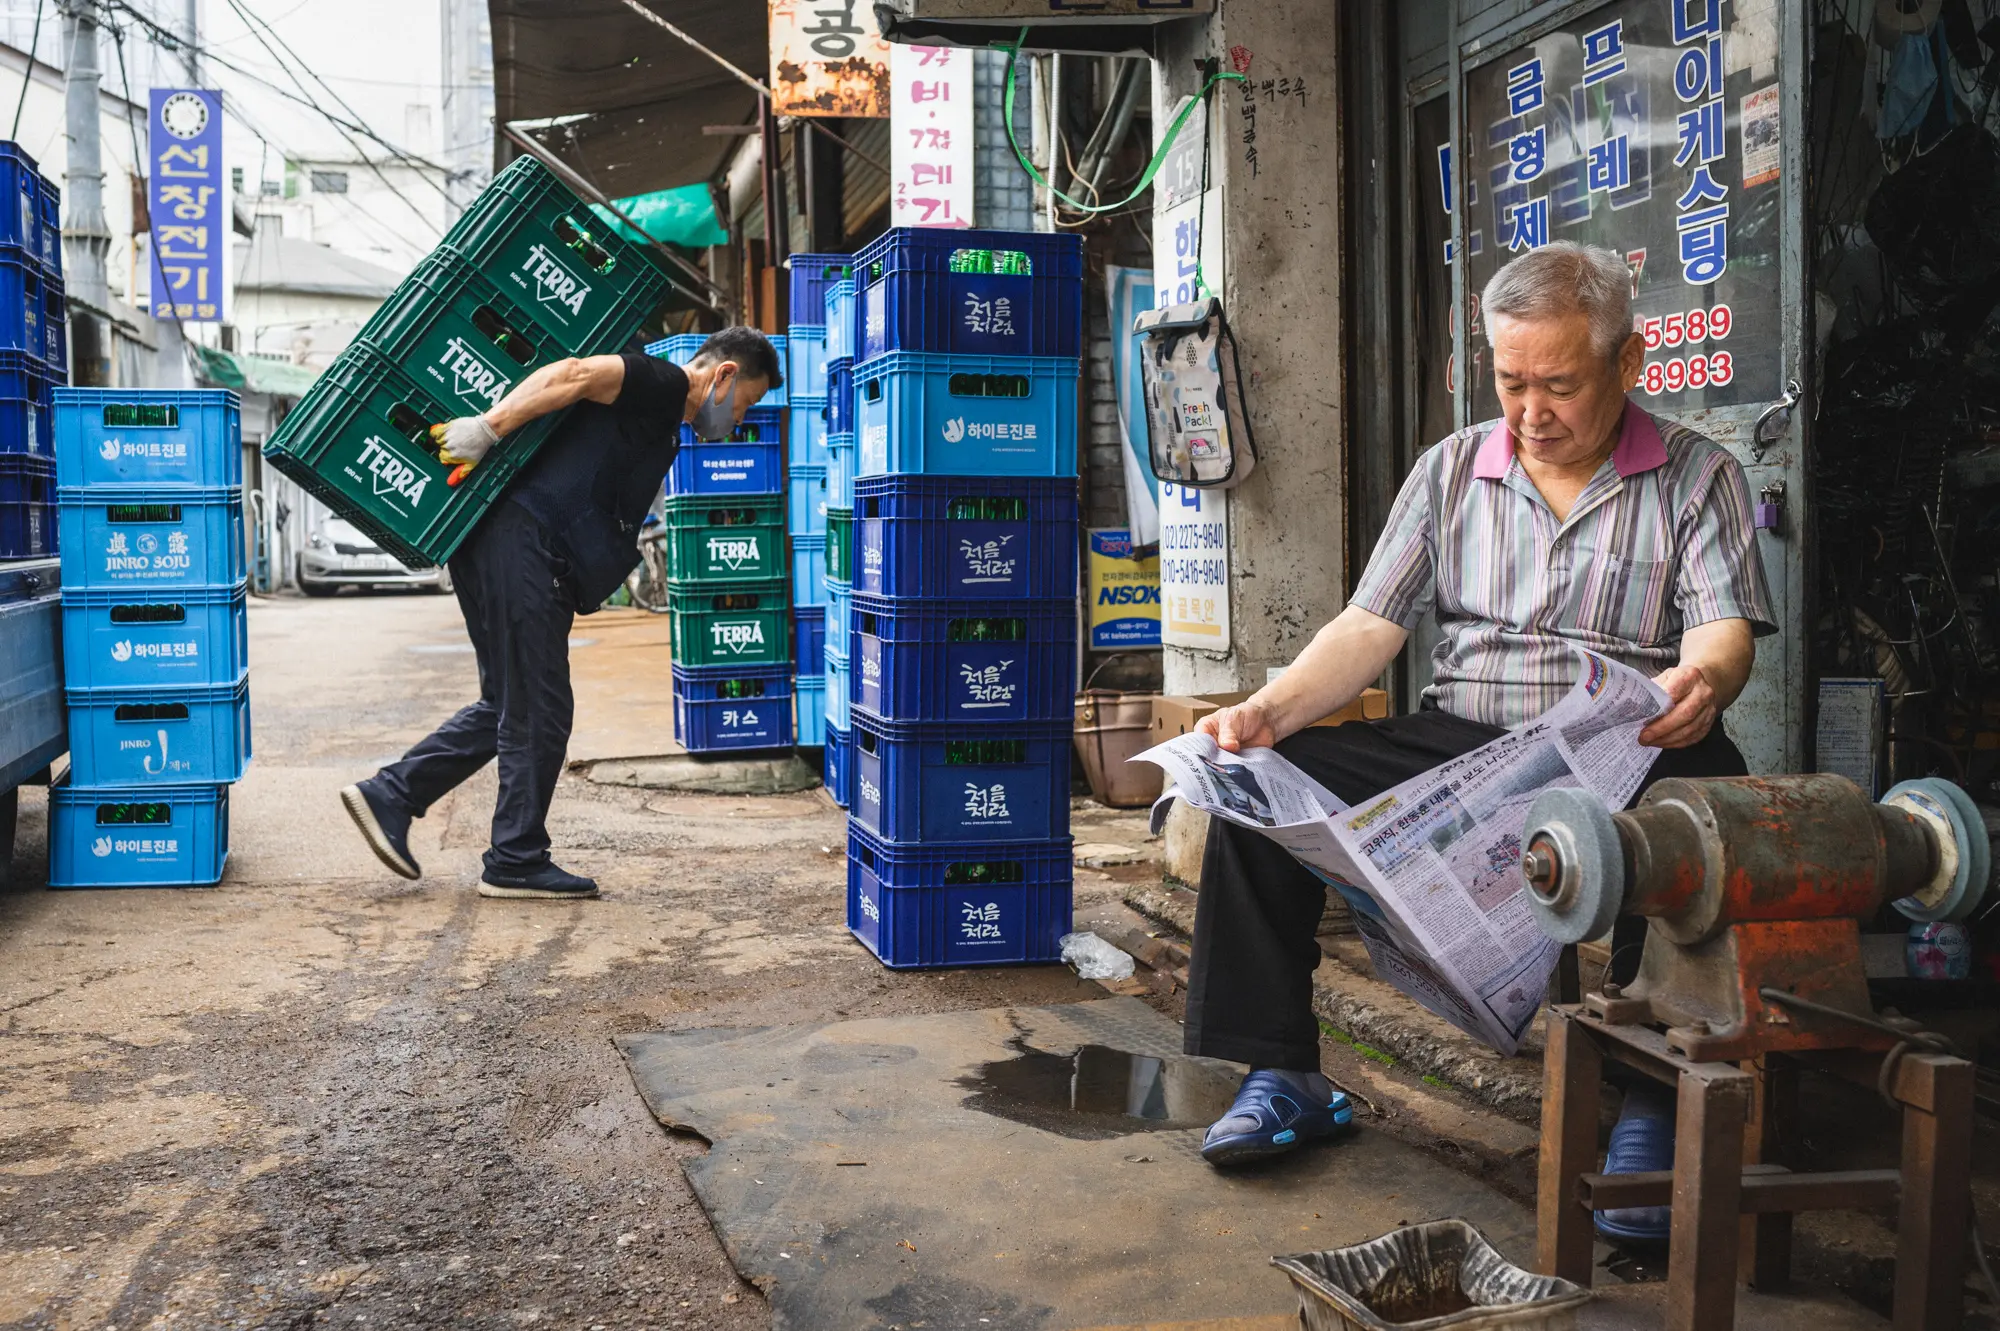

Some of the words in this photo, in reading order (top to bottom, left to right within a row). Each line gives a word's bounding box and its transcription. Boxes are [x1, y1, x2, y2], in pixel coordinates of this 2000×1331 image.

[802, 0, 865, 58] 공
[1175, 149, 1196, 188] 15
[158, 143, 216, 301] 선창전기
[521, 244, 588, 317] TERRA
[964, 292, 1012, 318] 처음
[964, 315, 1016, 336] 처럼
[439, 337, 508, 408] TERRA
[1182, 401, 1210, 414] Fresh
[1185, 414, 1213, 427] Pack!
[967, 423, 1037, 441] 하이트진로
[123, 443, 188, 458] 하이트진로
[356, 436, 428, 508] TERRA
[706, 539, 761, 562] TERRA
[959, 538, 1000, 559] 처음
[105, 556, 149, 571] JINRO
[153, 554, 191, 570] SOJU
[968, 559, 1013, 576] 처럼
[1097, 585, 1161, 606] NSOK
[710, 621, 765, 646] TERRA
[134, 642, 198, 658] 하이트진로
[959, 663, 1001, 684] 처음
[968, 684, 1013, 701] 처럼
[722, 709, 759, 728] 카스
[120, 739, 151, 751] JINRO
[964, 782, 1006, 804] 처음
[964, 802, 1010, 818] 처럼
[115, 839, 179, 854] 하이트진로
[962, 901, 1001, 922] 처음
[961, 923, 1002, 939] 처럼
